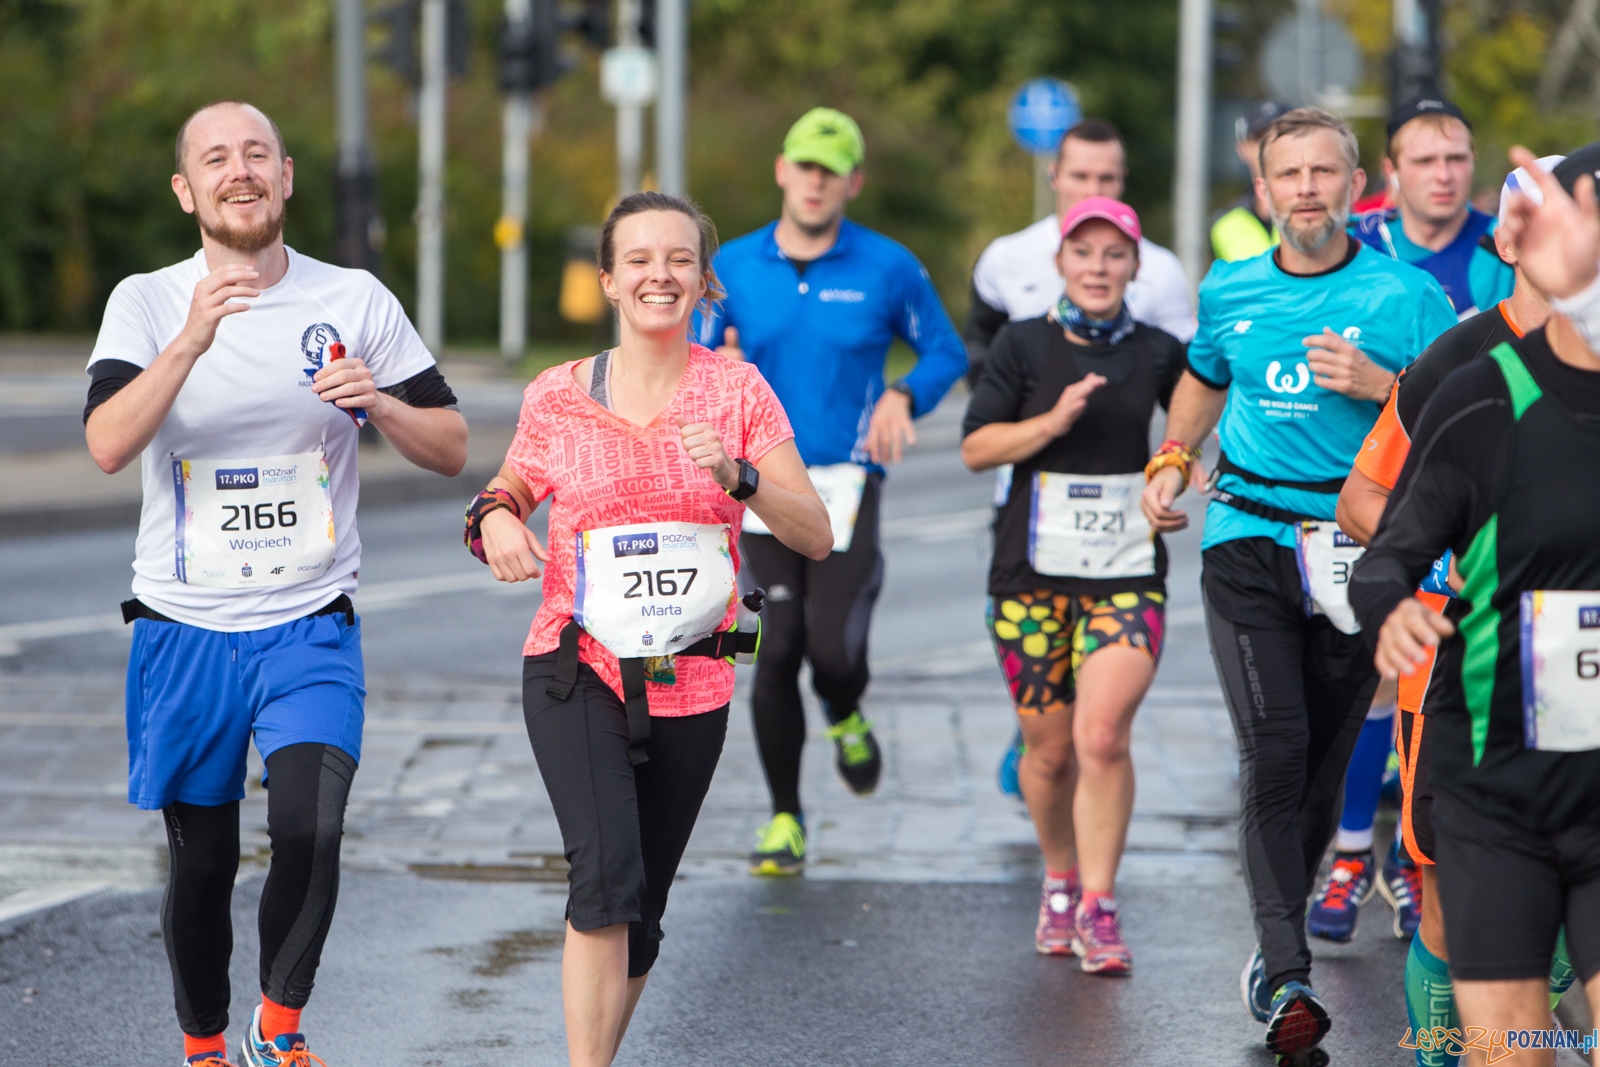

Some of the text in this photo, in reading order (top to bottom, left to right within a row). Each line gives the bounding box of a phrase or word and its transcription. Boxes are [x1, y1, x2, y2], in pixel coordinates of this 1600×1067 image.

[579, 444, 594, 482] MIND
[603, 440, 621, 478] BODY
[664, 441, 684, 490] MIND
[262, 475, 297, 484] maraton
[617, 475, 667, 496] BODY
[688, 482, 707, 490] SOUL
[586, 485, 613, 499] MIND
[644, 492, 675, 504] HAPPY
[221, 500, 297, 532] 2166
[595, 499, 639, 522] HAPPY
[1073, 510, 1126, 534] 1221
[229, 536, 291, 551] Wojciech
[662, 542, 698, 550] maraton
[623, 568, 698, 599] 2167
[1332, 561, 1348, 585] 3
[641, 605, 682, 617] Marta
